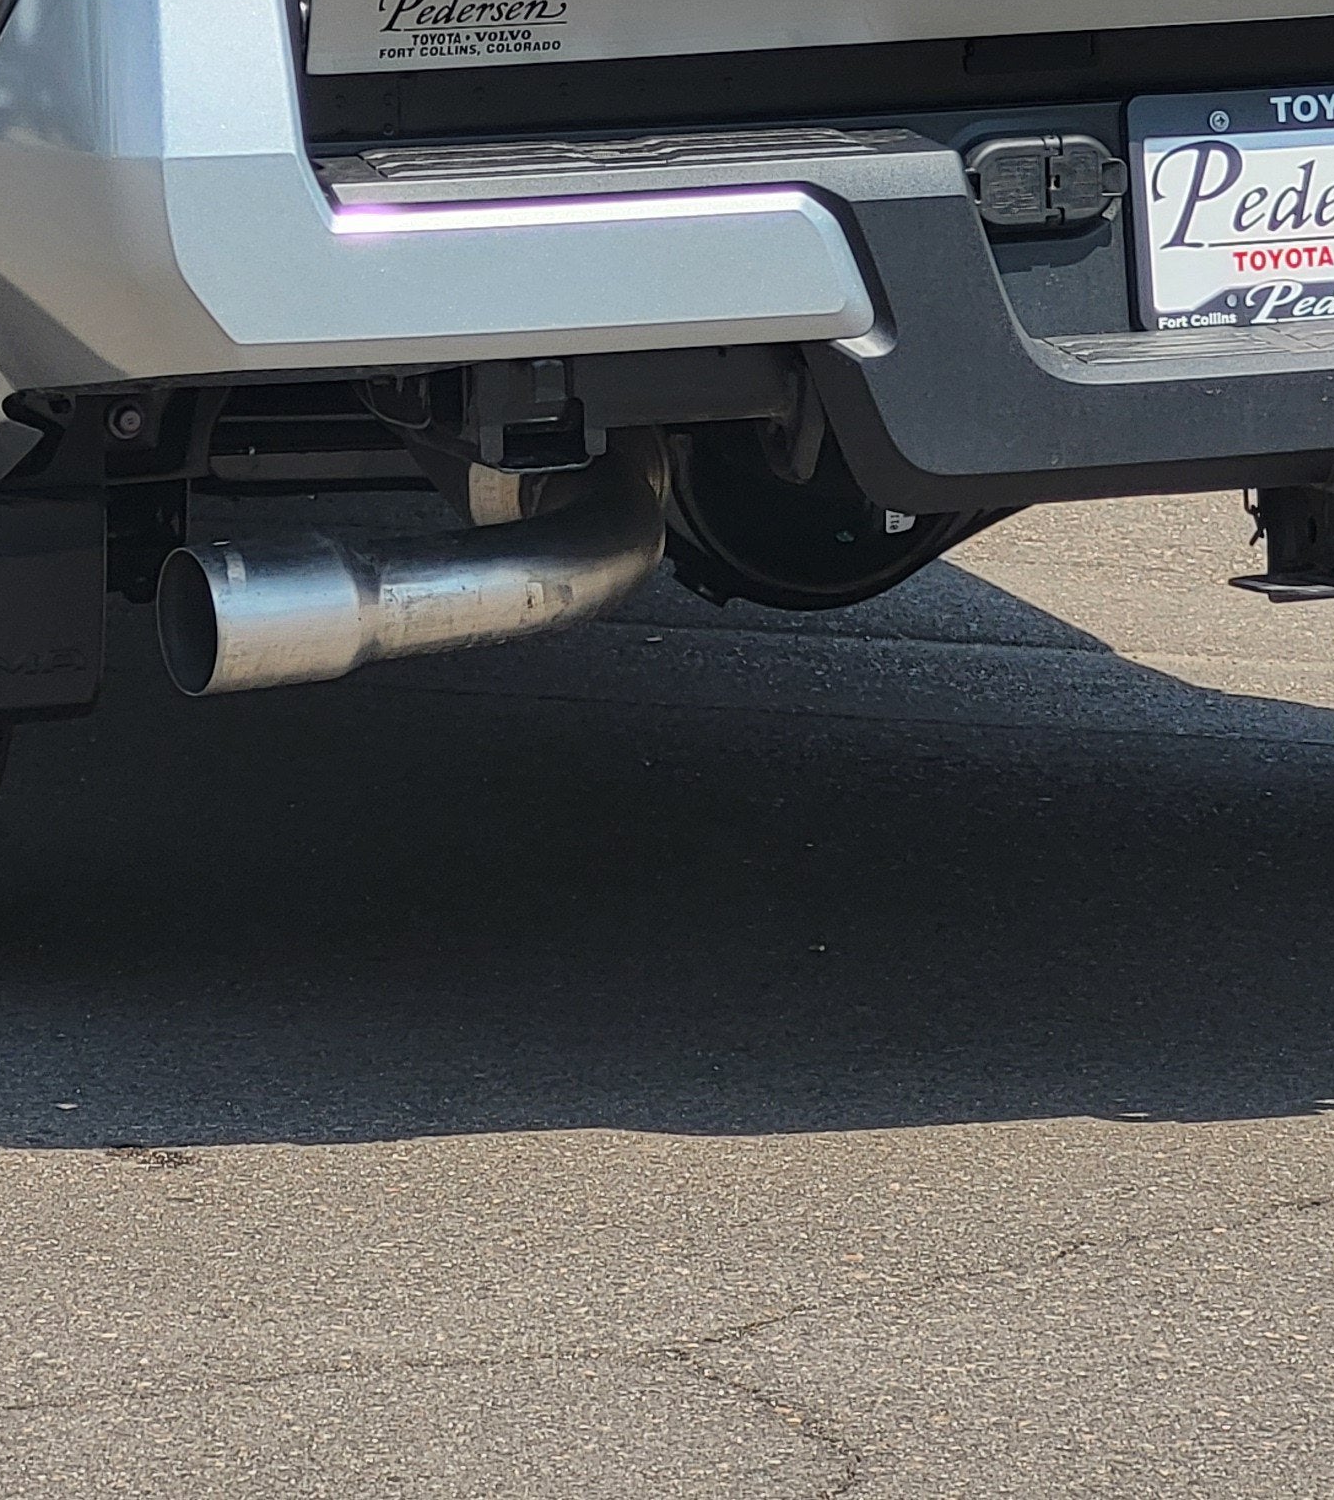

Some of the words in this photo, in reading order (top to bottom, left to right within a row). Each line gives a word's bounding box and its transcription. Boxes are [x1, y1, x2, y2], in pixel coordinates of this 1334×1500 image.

[412, 33, 461, 46] TOYOTA
[474, 29, 532, 42] VOLVO
[379, 47, 415, 59] FORT
[420, 44, 481, 57] COLLINS,
[486, 40, 561, 54] COLORADO
[1233, 246, 1334, 271] TOYOTA
[1158, 315, 1188, 330] Fort
[1190, 312, 1238, 328] Collins
